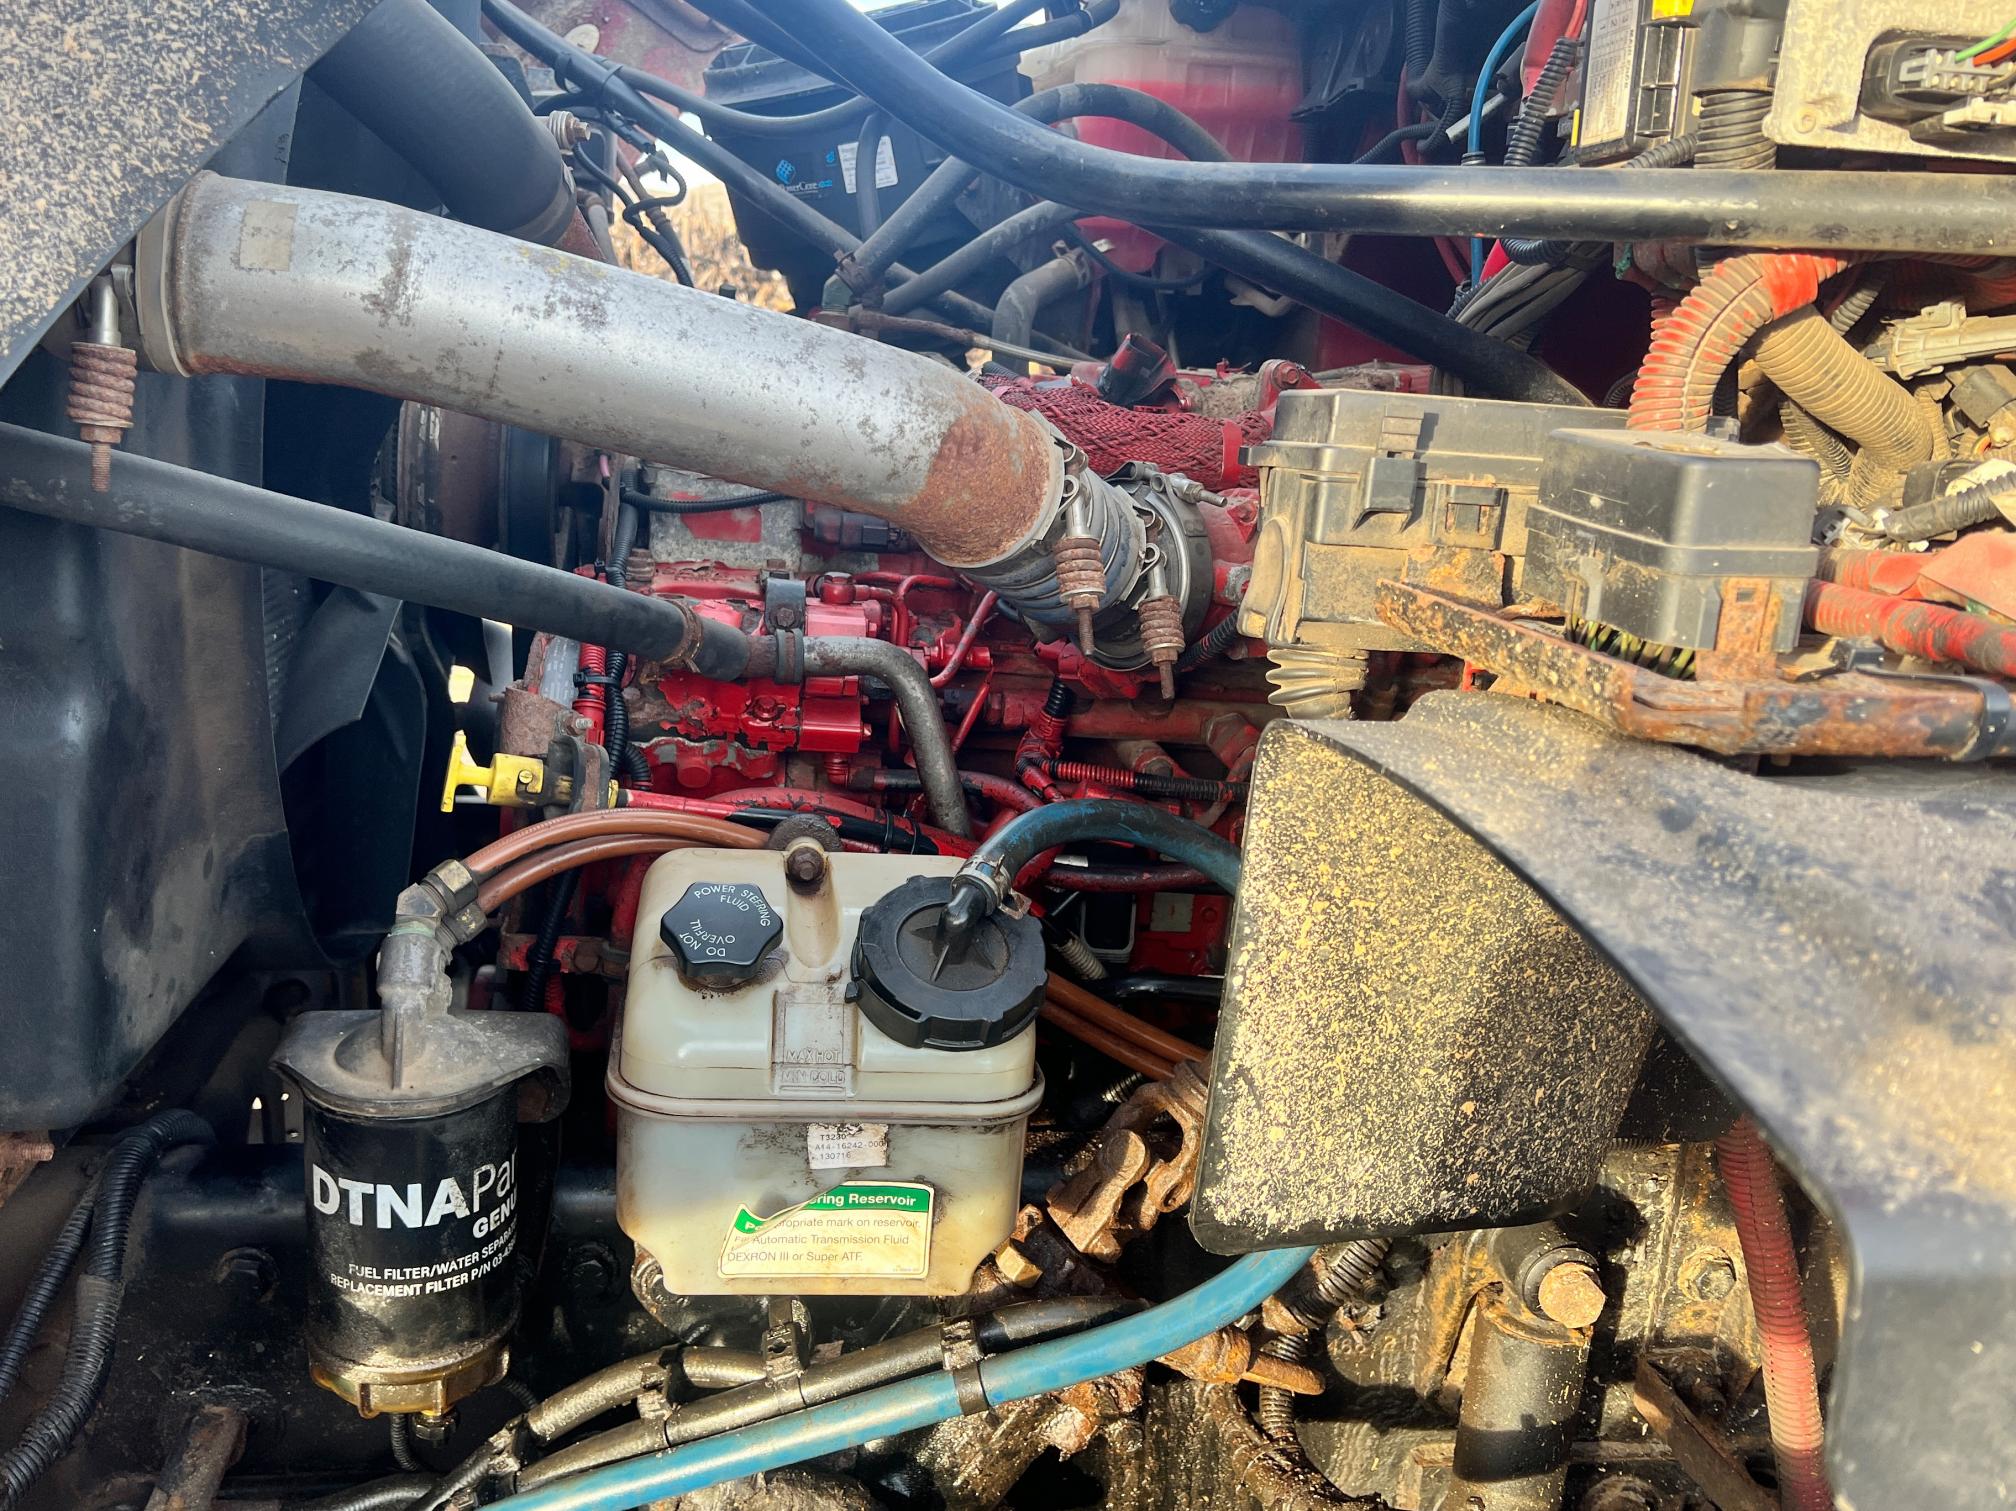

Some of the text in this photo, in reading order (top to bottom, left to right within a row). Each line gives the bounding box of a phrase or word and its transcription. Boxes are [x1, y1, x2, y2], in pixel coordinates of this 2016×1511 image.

[694, 885, 771, 927] POWER STEERING
[720, 895, 750, 912] FLUID
[689, 919, 736, 945] OVERFILL
[679, 932, 726, 957] DO NOT
[815, 1047, 841, 1062] HOT
[849, 1193, 917, 1206] Reservoir
[826, 1218, 854, 1227] mark
[856, 1219, 870, 1227] on
[752, 1235, 807, 1245] Automatic
[811, 1234, 880, 1245] Transmission
[883, 1233, 909, 1245] Fluid
[348, 1263, 382, 1280] FUEL
[384, 1251, 480, 1280] FILTER/WATER
[727, 1251, 776, 1262] DEXRON
[779, 1251, 789, 1262] III
[792, 1253, 803, 1261] or
[806, 1251, 838, 1263] Super
[330, 1273, 423, 1298] REPLACEMENT
[425, 1272, 469, 1295] FILTER
[471, 1261, 491, 1281] P/N
